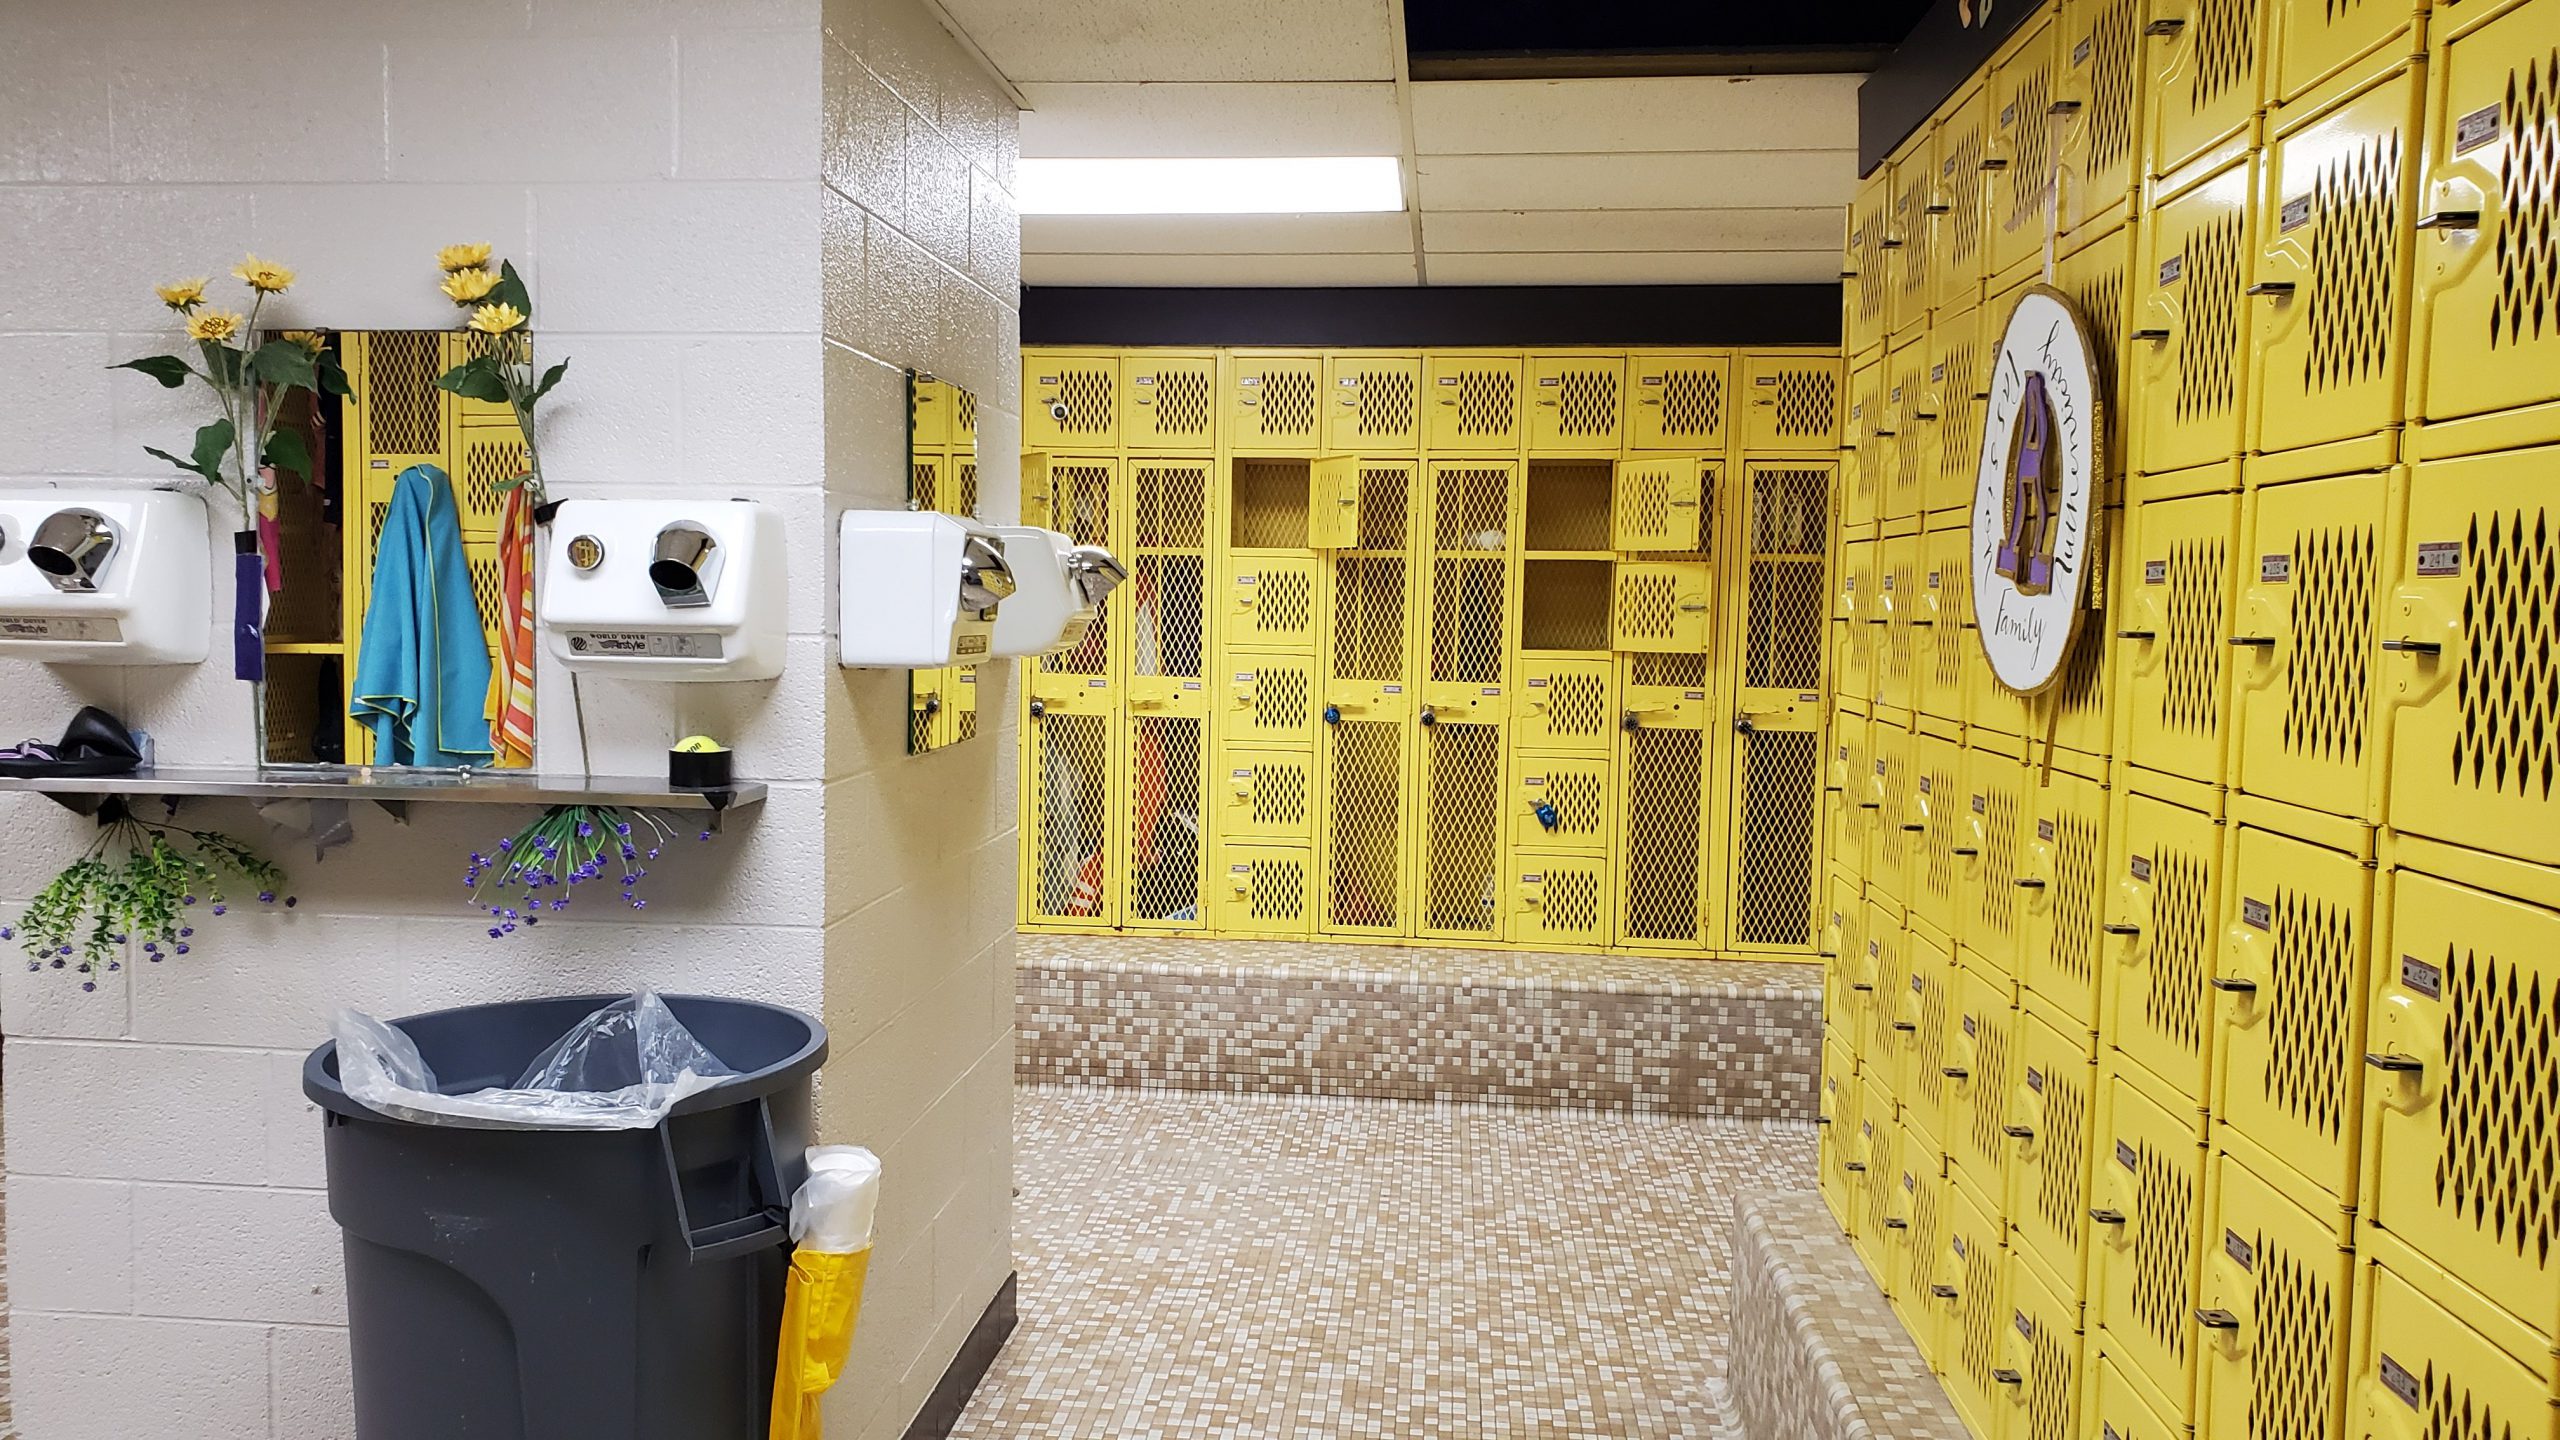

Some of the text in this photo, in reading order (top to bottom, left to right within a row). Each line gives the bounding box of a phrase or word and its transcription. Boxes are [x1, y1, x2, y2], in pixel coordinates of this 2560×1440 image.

[1983, 349, 2021, 595] Passion
[2429, 552, 2445, 568] 241
[1995, 587, 2047, 671] Family
